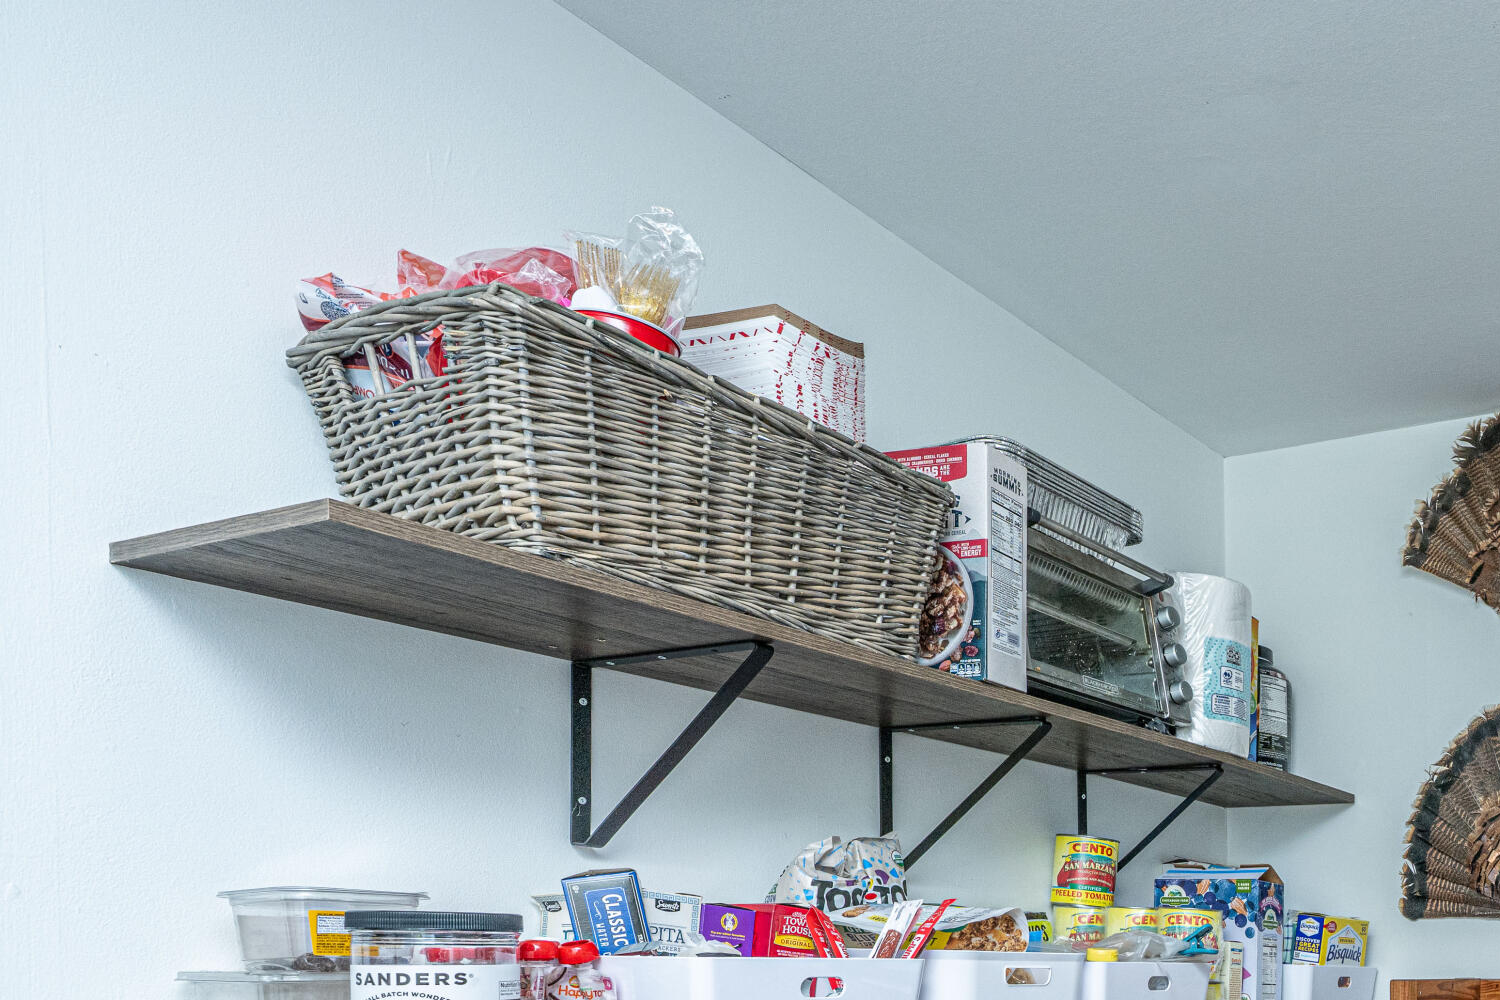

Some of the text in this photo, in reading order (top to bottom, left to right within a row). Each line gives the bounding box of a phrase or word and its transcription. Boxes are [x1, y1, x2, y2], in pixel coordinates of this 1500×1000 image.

[992, 473, 1022, 496] SUMMIT
[960, 549, 982, 557] ENERGY
[1072, 842, 1113, 857] CENTO
[1064, 862, 1080, 872] SAN
[1055, 889, 1114, 901] PEELED TOMATO
[602, 893, 629, 948] CLASSIC
[1078, 914, 1104, 924] CEN
[1132, 914, 1157, 924] CEN
[596, 923, 610, 948] WATER
[650, 926, 685, 944] PITA
[780, 940, 811, 948] ORIGINAL
[1326, 944, 1362, 964] Bisquick
[356, 972, 468, 986] SANDERS
[381, 991, 409, 999] BATCH
